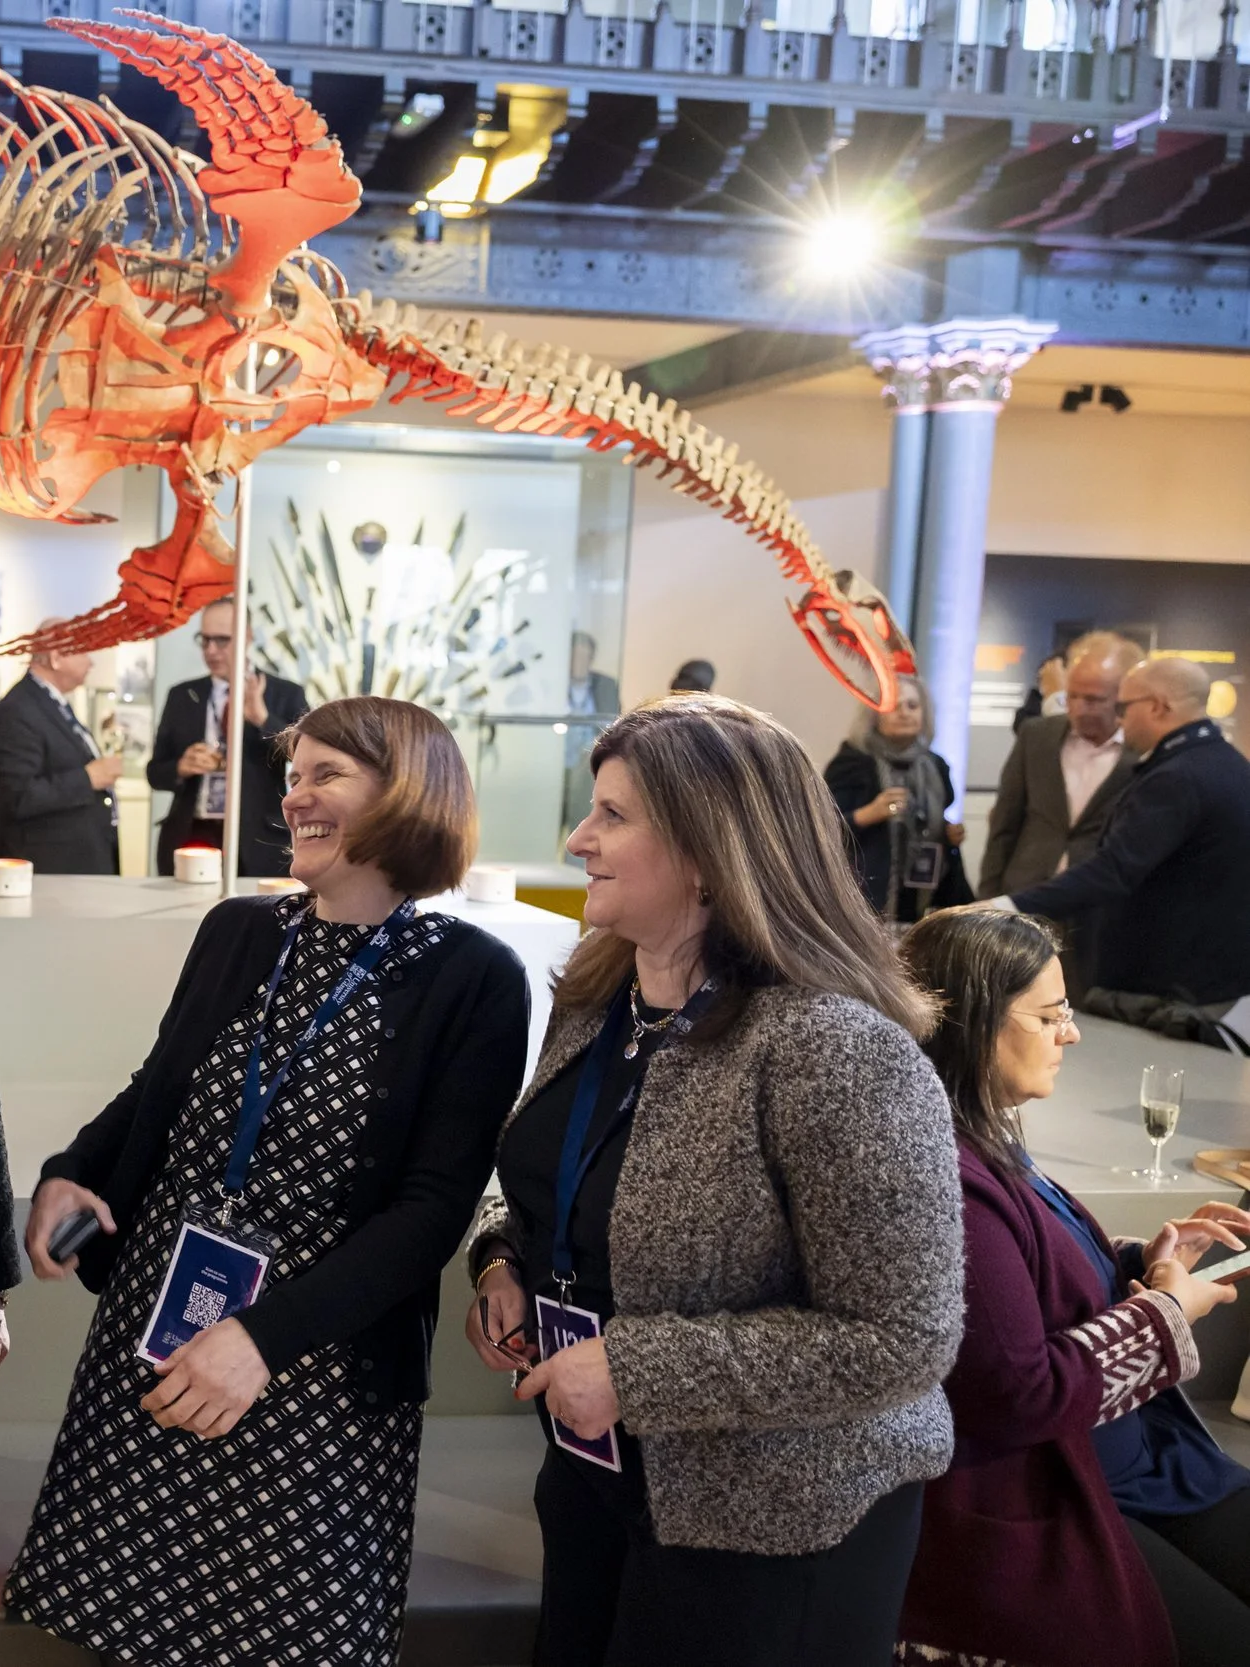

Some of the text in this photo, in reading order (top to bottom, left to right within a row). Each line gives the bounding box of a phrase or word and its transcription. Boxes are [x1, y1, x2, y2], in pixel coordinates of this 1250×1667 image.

[331, 977, 350, 1001] Glasgow
[337, 977, 360, 1006] University
[554, 1325, 585, 1349] U2
